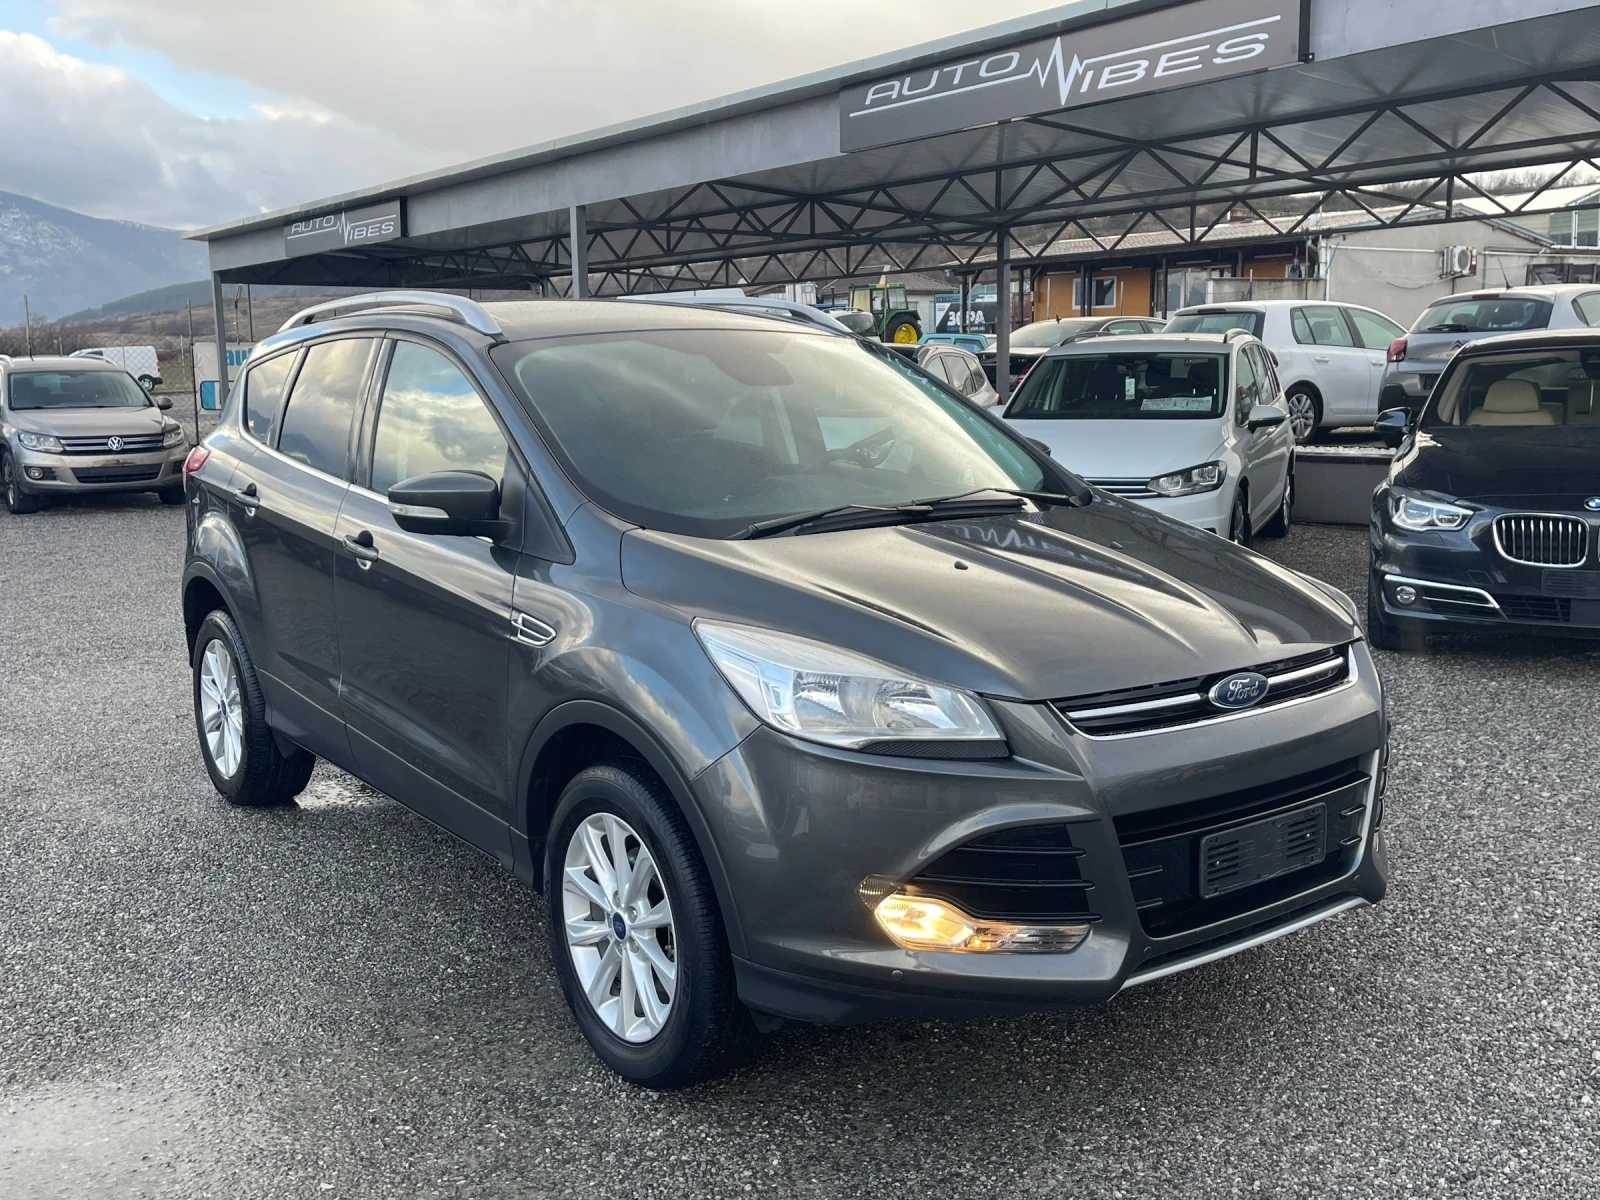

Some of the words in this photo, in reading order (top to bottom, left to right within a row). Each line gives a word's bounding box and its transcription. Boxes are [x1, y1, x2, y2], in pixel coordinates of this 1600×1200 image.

[865, 51, 1020, 105] AUTO
[291, 215, 335, 234] AUTO
[1227, 678, 1260, 701] Ford
